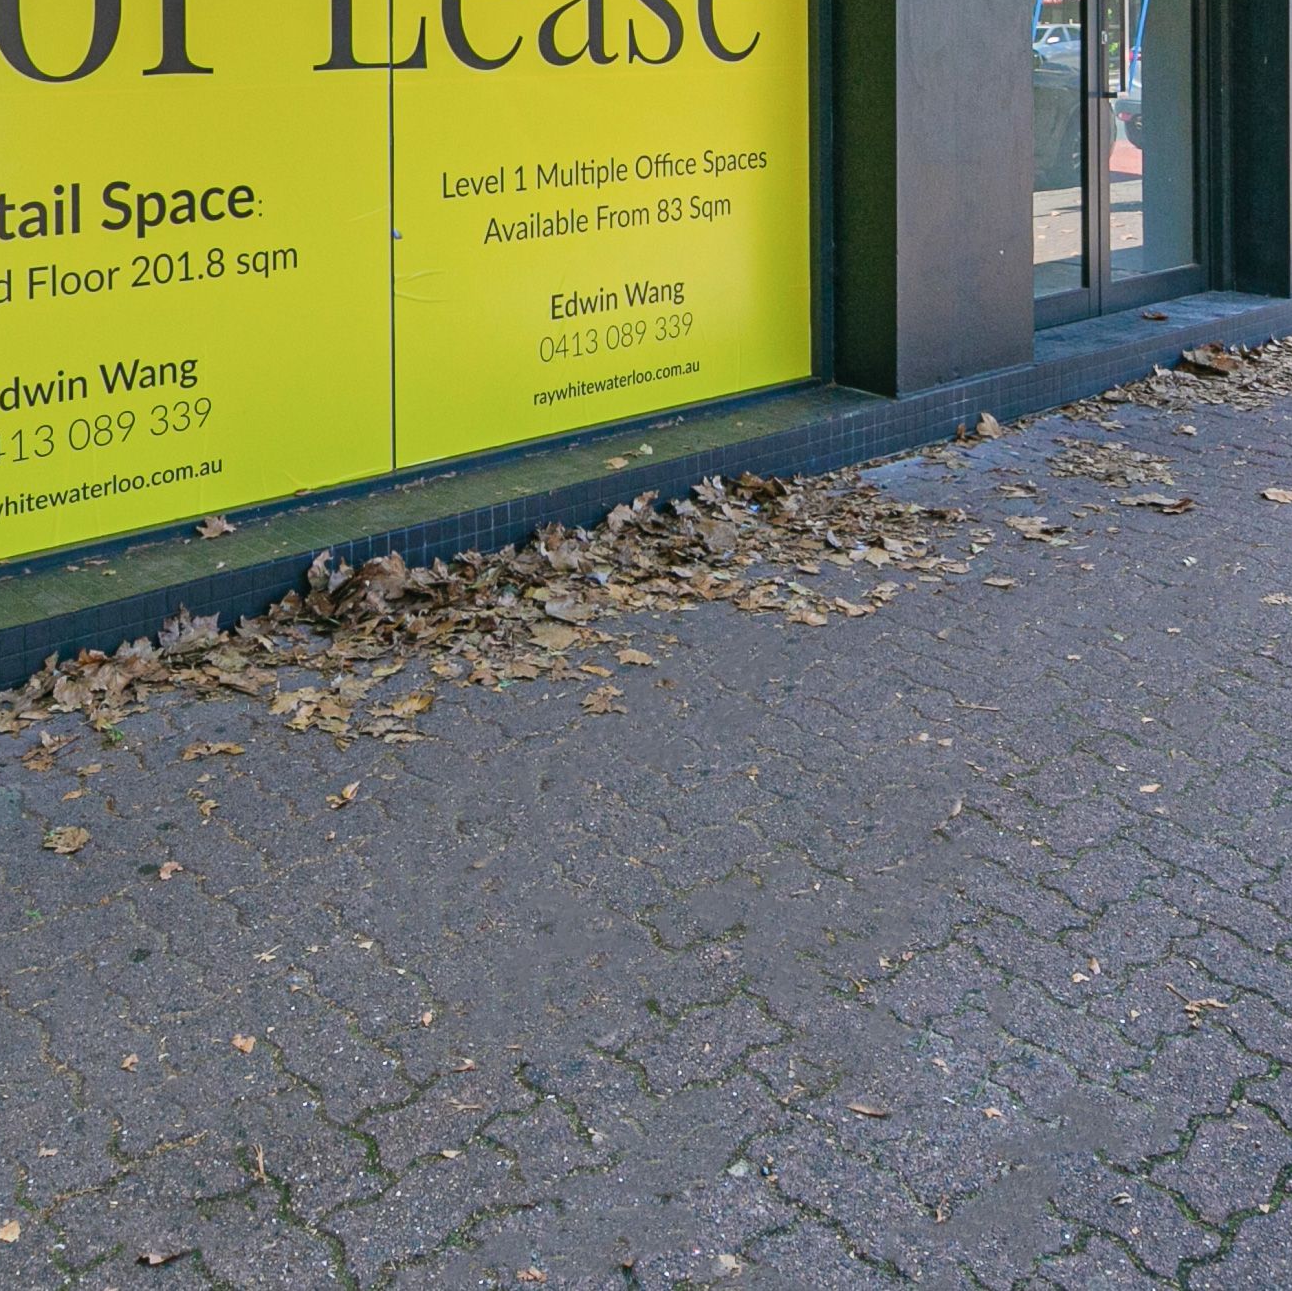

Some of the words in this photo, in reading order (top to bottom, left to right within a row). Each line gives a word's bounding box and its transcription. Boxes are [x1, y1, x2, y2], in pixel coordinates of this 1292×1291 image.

[442, 166, 505, 199] Level
[514, 166, 525, 192] 1
[537, 157, 628, 191] Multiple
[635, 154, 696, 180] Office
[703, 149, 767, 179] Spaces
[483, 208, 588, 244] Available
[597, 205, 650, 231] From
[657, 197, 683, 223] 83
[689, 195, 731, 223] Sqm
[28, 261, 120, 300] Floor
[131, 247, 226, 289] 201.8
[236, 243, 298, 276] sqm
[551, 287, 617, 320] Edwin
[625, 280, 685, 306] Wang
[539, 328, 598, 363] 0413
[606, 320, 647, 350] 089
[654, 311, 694, 341] 339
[100, 358, 199, 395] Wang
[533, 358, 700, 406] raywhitewaterloo.com.au
[68, 410, 136, 452] 089
[150, 397, 212, 438] 339
